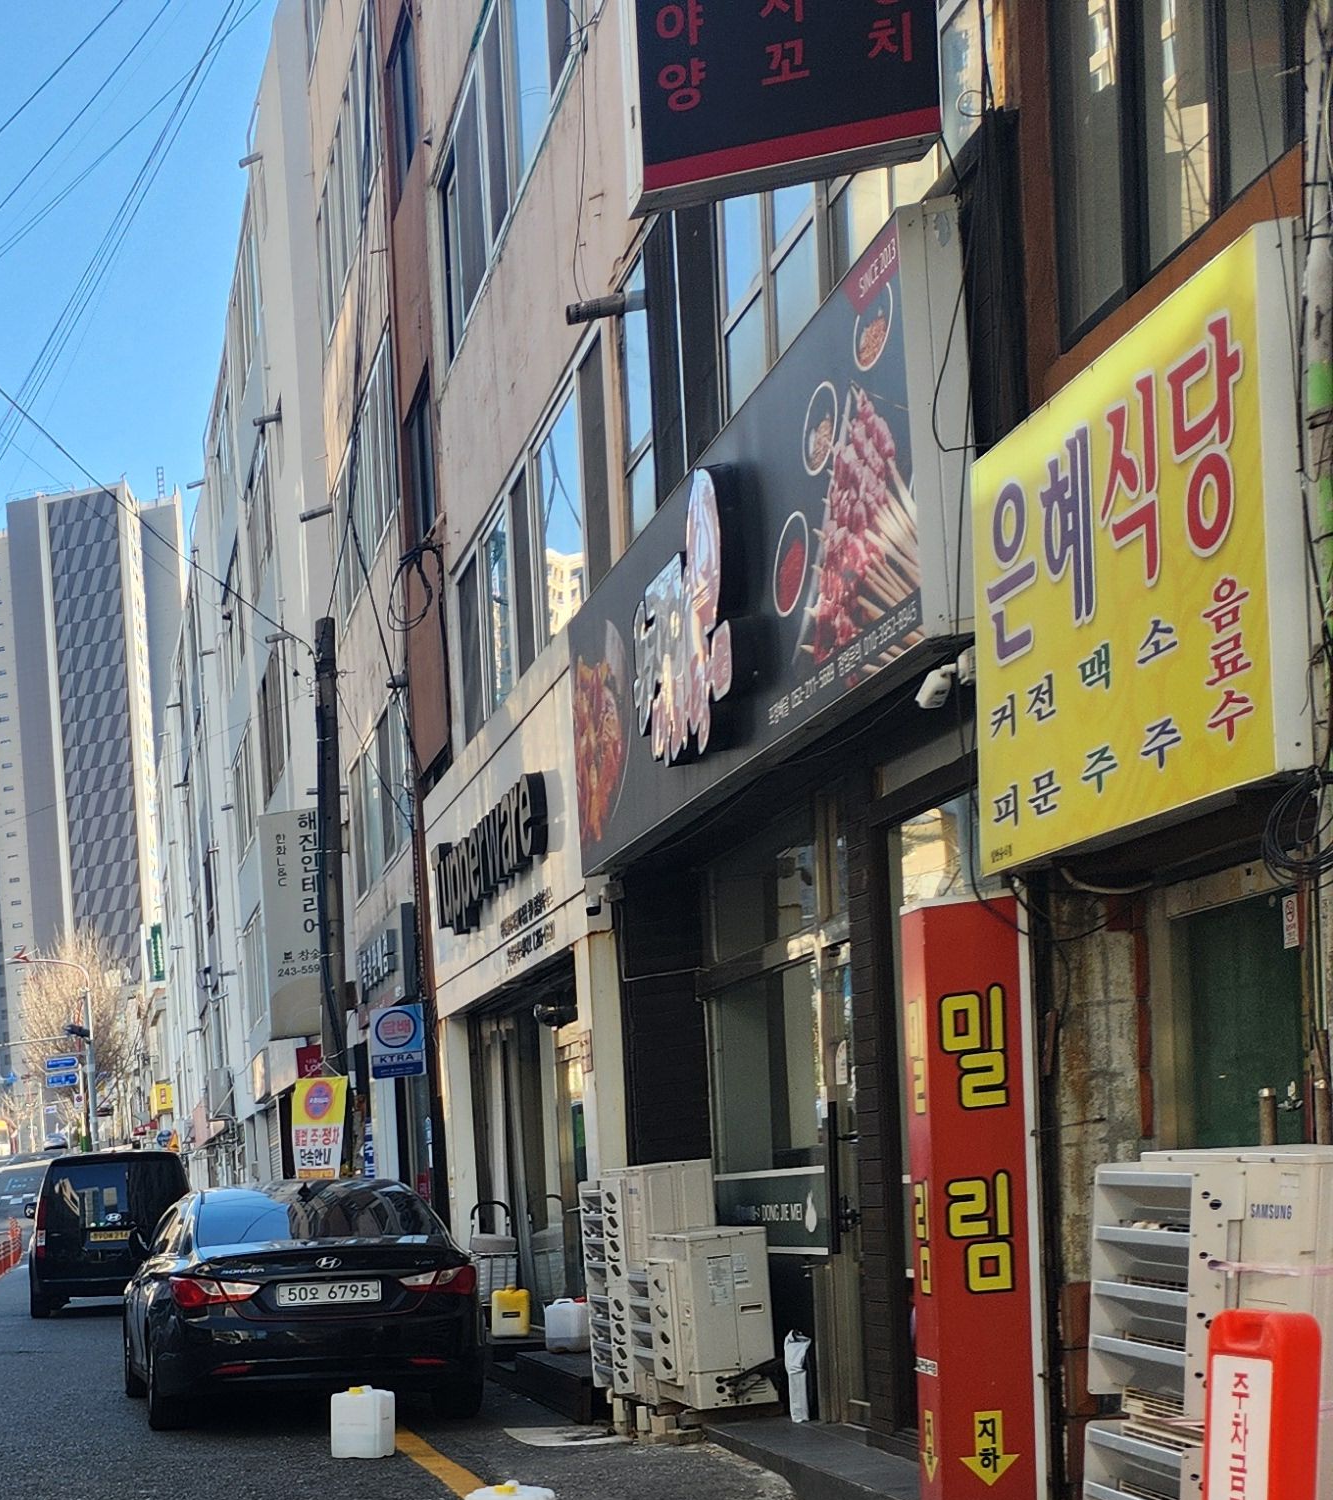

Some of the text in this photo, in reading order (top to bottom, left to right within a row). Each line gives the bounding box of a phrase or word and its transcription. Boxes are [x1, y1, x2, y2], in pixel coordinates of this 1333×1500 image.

[859, 237, 896, 299] SINCE 2013
[984, 317, 1242, 666] 은혜식당
[1202, 577, 1254, 742] 음료수
[431, 773, 539, 935] Tupperware
[277, 963, 321, 978] 243-559
[379, 1053, 414, 1064] KTRA
[940, 984, 1018, 1294] 밀림
[1250, 1202, 1293, 1220] SAMSUNG
[287, 1284, 371, 1302] 50오 6795
[978, 1417, 1001, 1473] 지하
